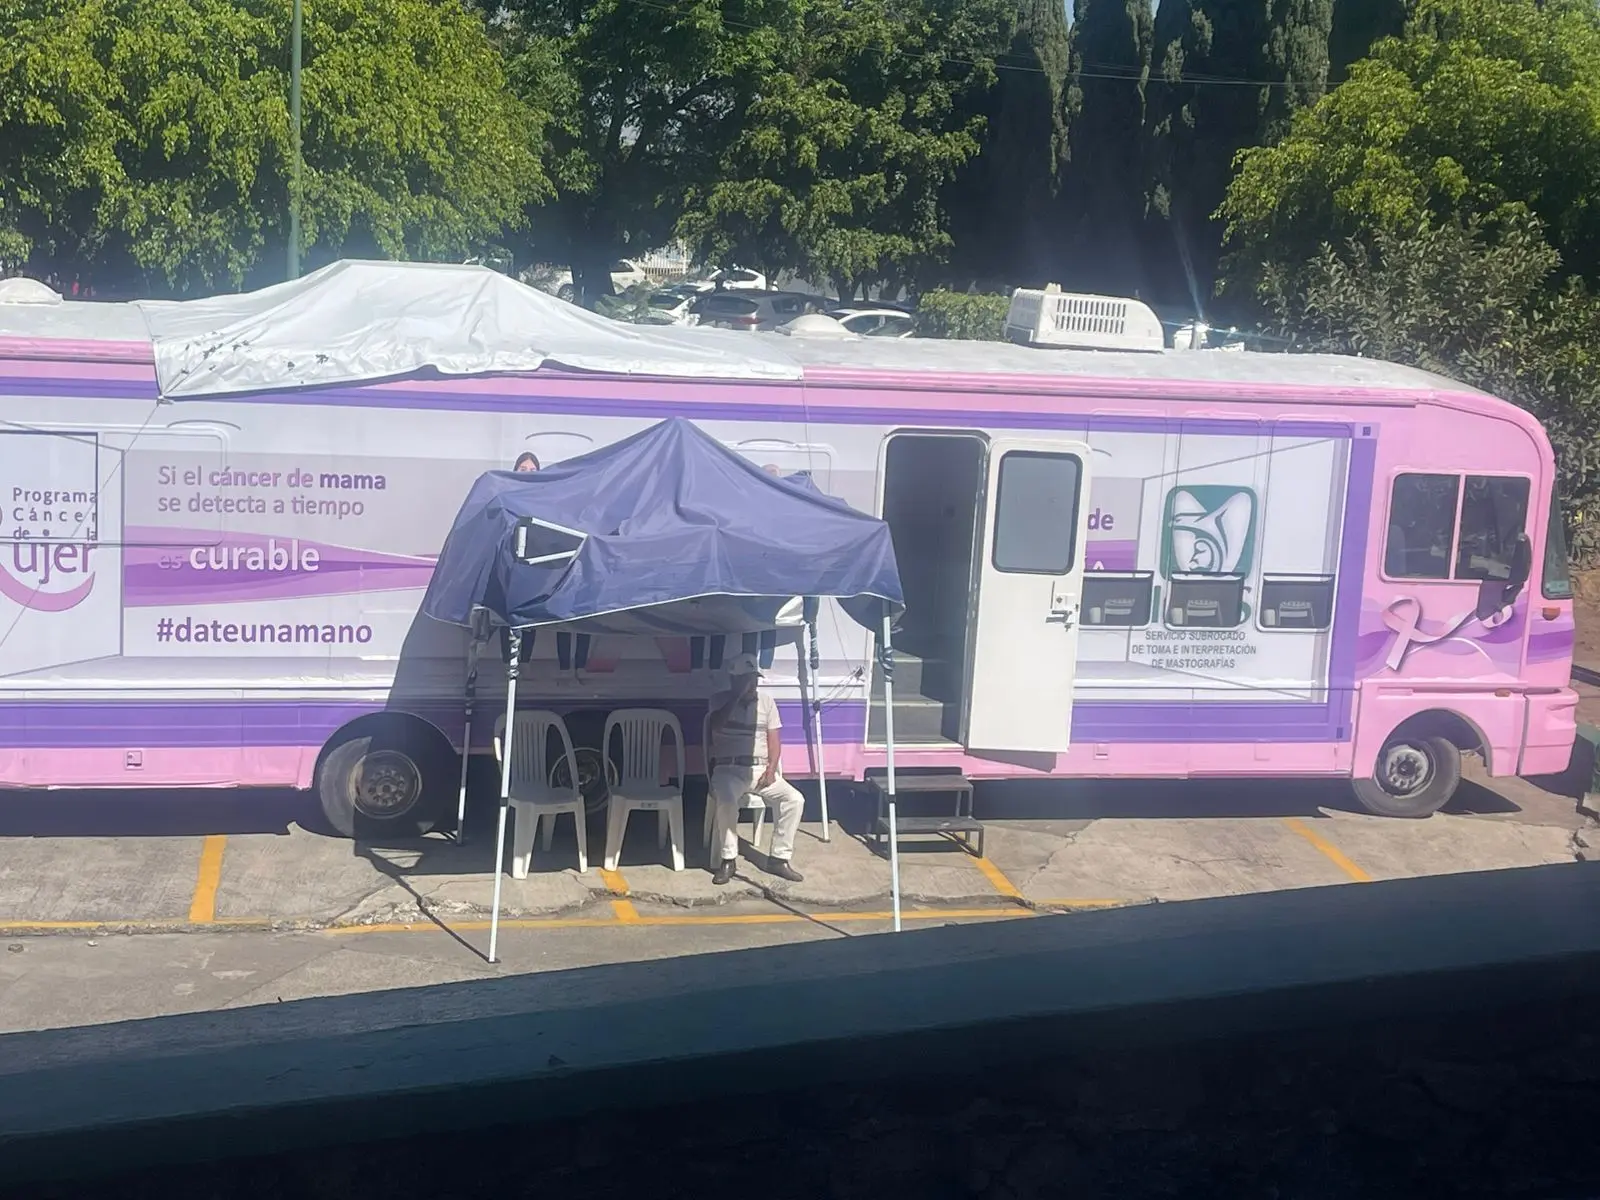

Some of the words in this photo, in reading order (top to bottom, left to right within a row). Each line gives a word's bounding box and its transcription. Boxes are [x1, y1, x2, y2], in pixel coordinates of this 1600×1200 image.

[159, 466, 176, 486] Si
[184, 466, 202, 486] el
[209, 467, 281, 487] cáncer
[287, 468, 313, 488] de
[320, 472, 387, 490] mama
[13, 487, 97, 505] Programa
[159, 497, 181, 512] se
[188, 493, 266, 514] detecta
[273, 500, 285, 514] a
[292, 495, 364, 519] tiempo
[1087, 508, 1114, 530] de
[13, 526, 30, 540] de
[159, 554, 181, 571] es
[190, 539, 320, 572] curable
[157, 617, 372, 643] #dateunamano
[1145, 631, 1186, 641] SERVICIO
[1189, 631, 1245, 641] SUBROGADO
[1132, 645, 1144, 655] DE
[1147, 645, 1171, 655] TOMA
[1173, 645, 1179, 655] E
[1152, 659, 1164, 669] DE
[1166, 657, 1236, 669] MASTOGRAFÍAS
